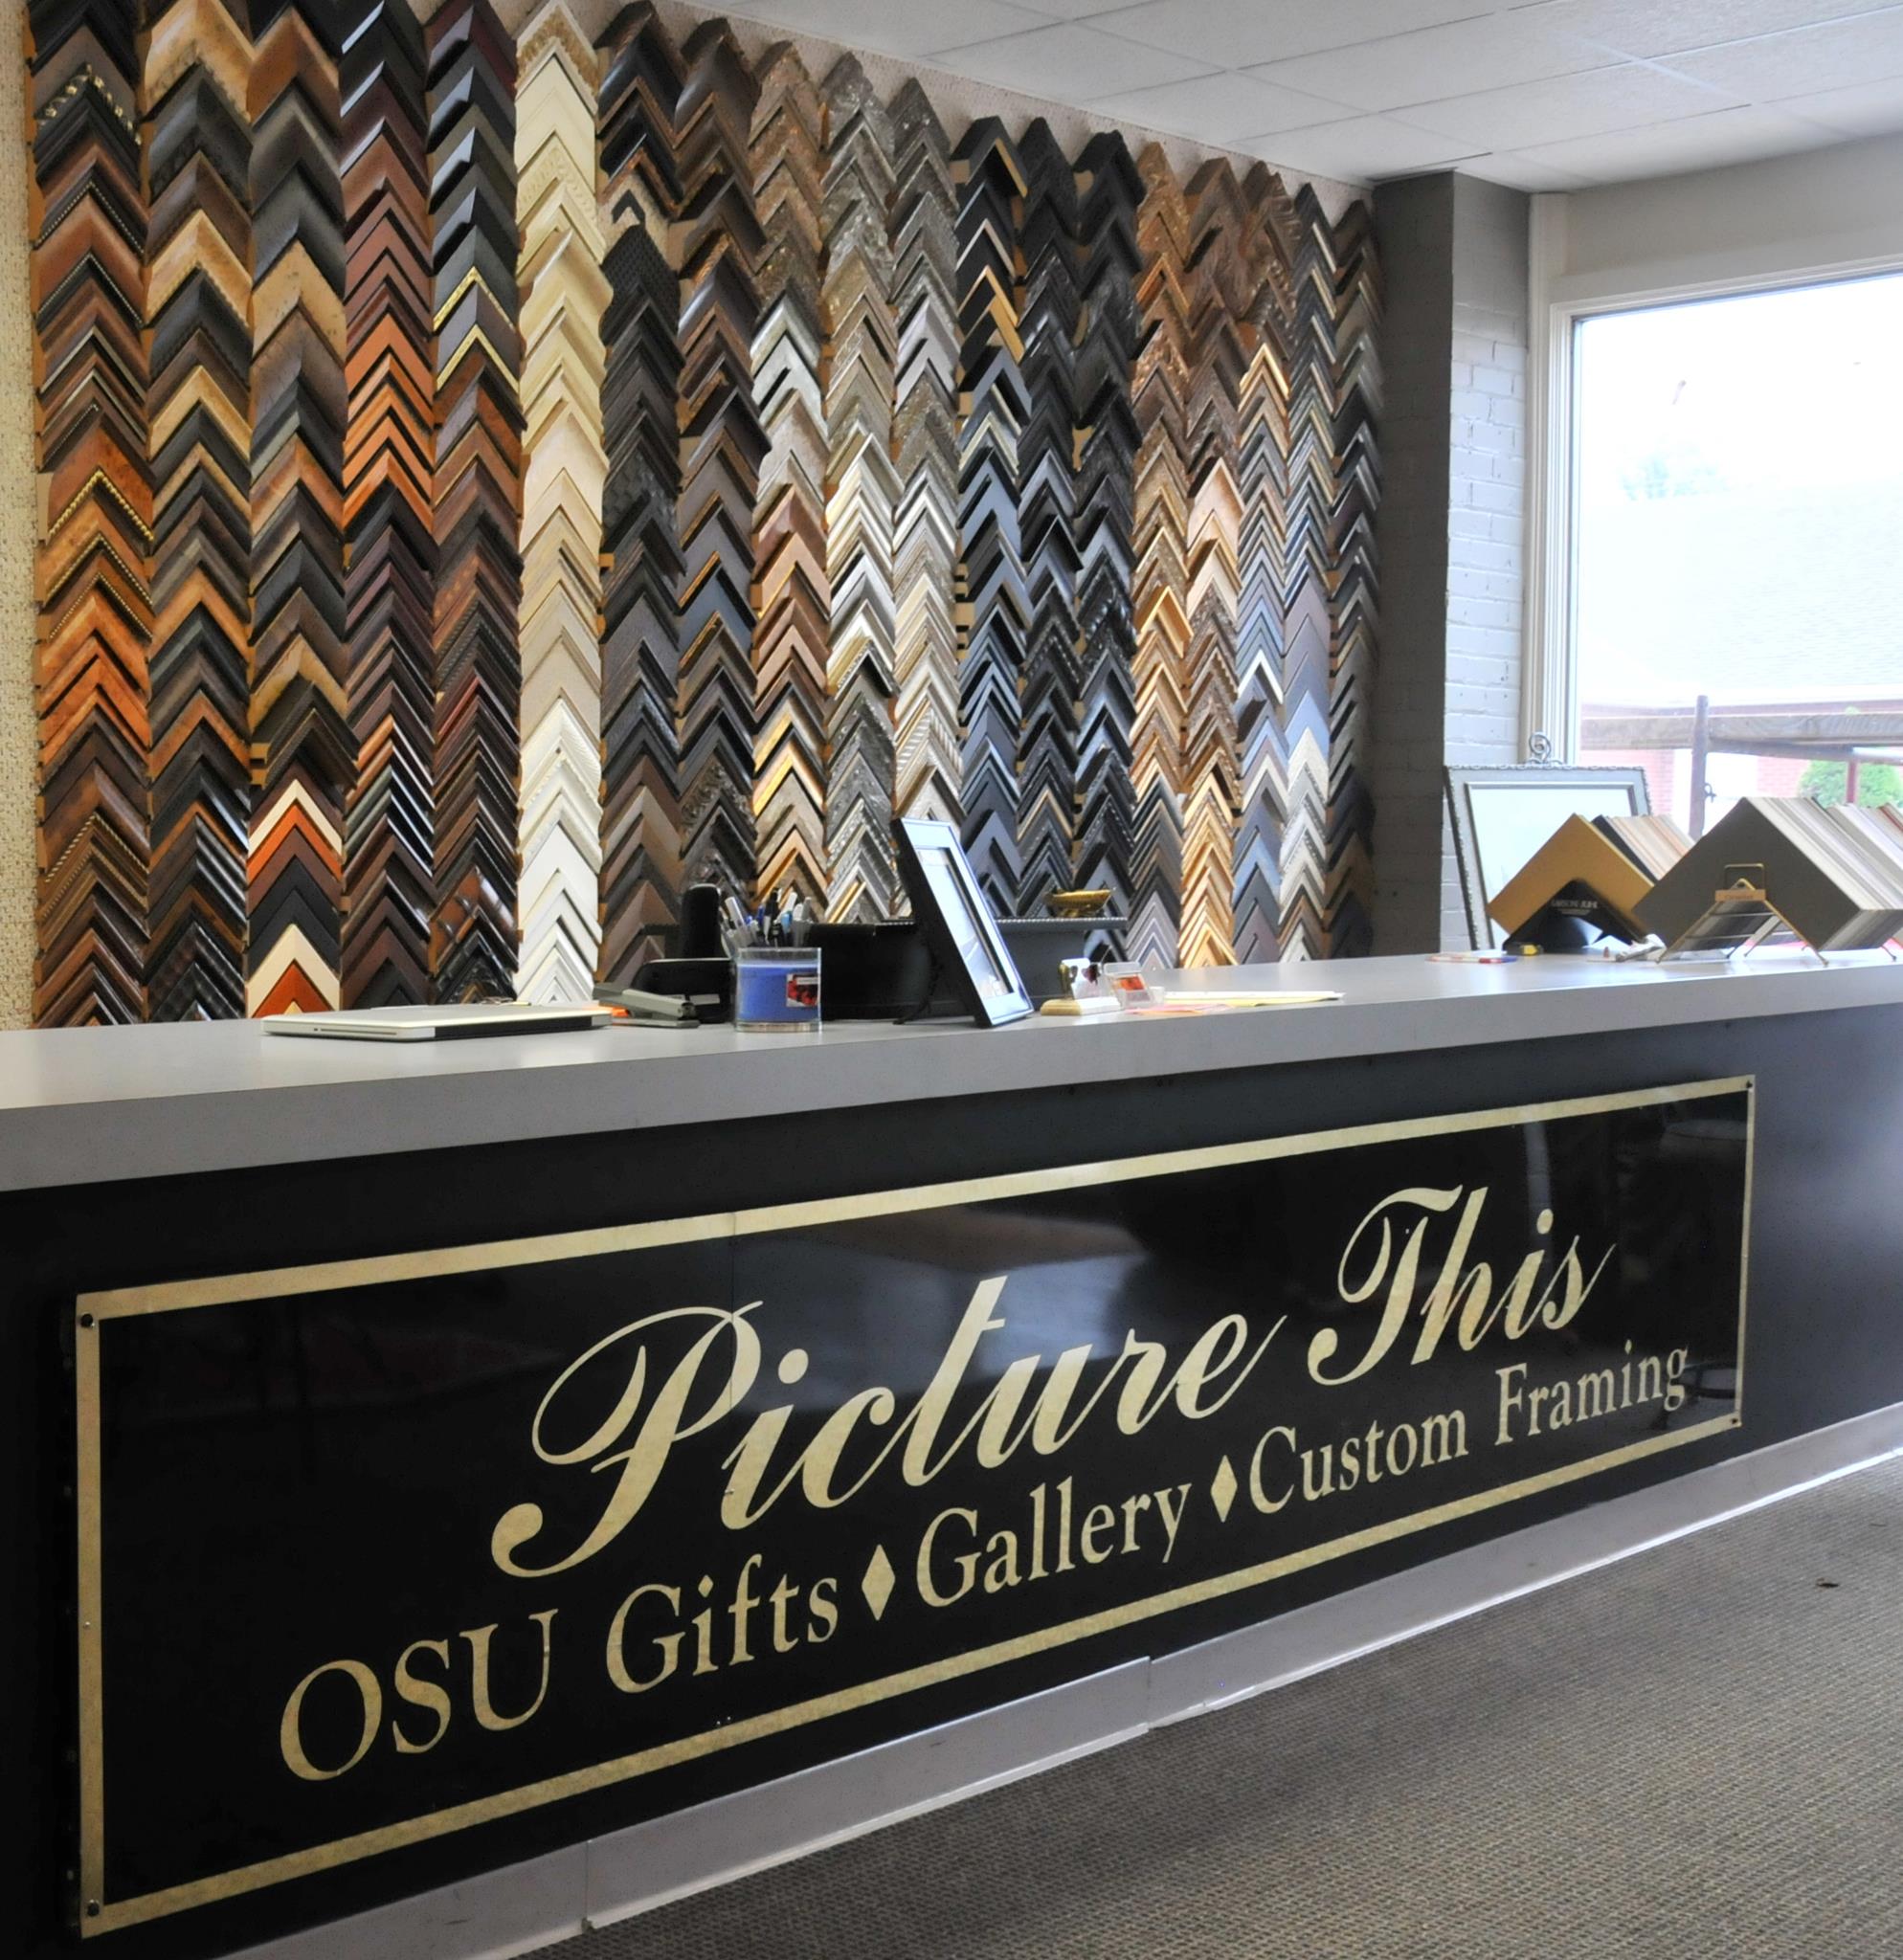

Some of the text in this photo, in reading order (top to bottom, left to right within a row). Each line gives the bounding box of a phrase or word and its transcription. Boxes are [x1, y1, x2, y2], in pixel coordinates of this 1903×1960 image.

[280, 1340, 1690, 1781] OSU Gifts Gallery Custom Framing
[492, 1185, 1617, 1578] Picture This
